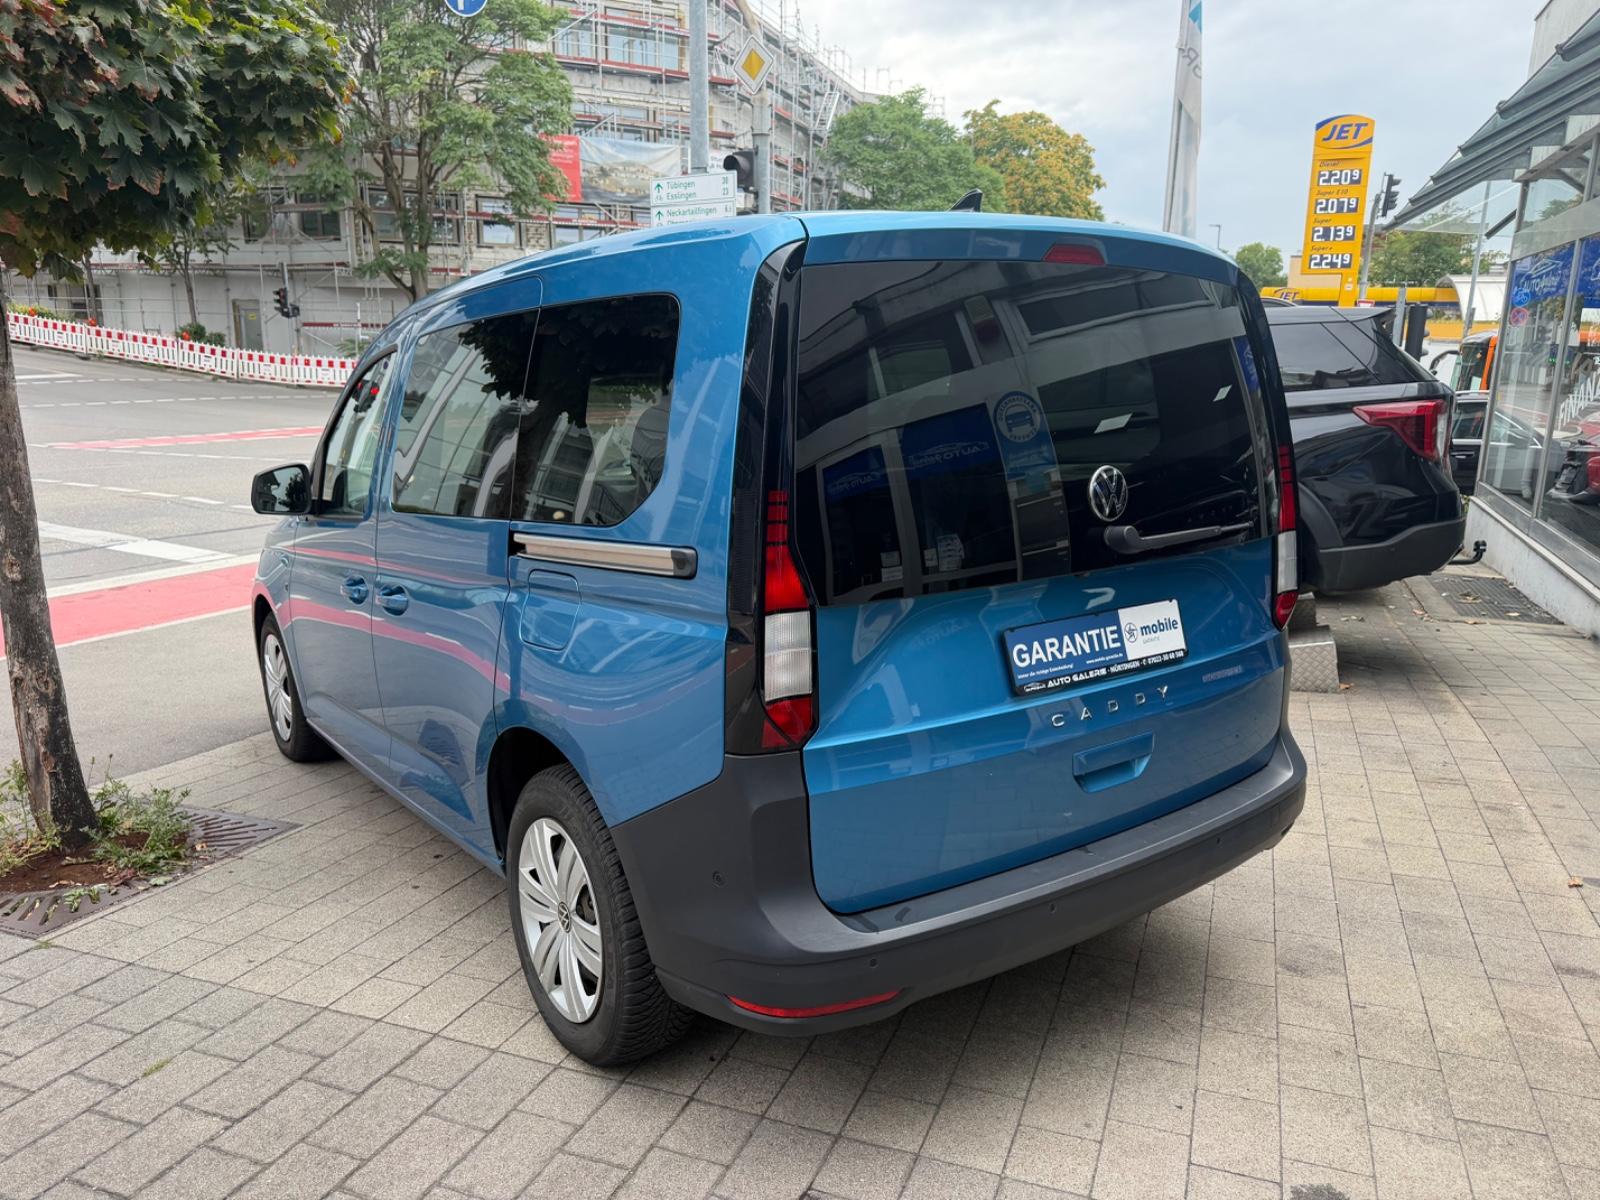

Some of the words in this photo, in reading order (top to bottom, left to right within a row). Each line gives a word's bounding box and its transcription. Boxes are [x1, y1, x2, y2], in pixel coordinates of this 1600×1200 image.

[1322, 122, 1369, 142] JET
[666, 191, 697, 201] Esslingen
[1313, 217, 1332, 226] Super
[1281, 291, 1300, 301] JET
[1140, 616, 1179, 637] mobile
[1012, 625, 1122, 668] GARANTIE
[1047, 675, 1072, 689] AUTO
[1072, 667, 1108, 682] GALERIE
[1051, 685, 1169, 728] CADDY
